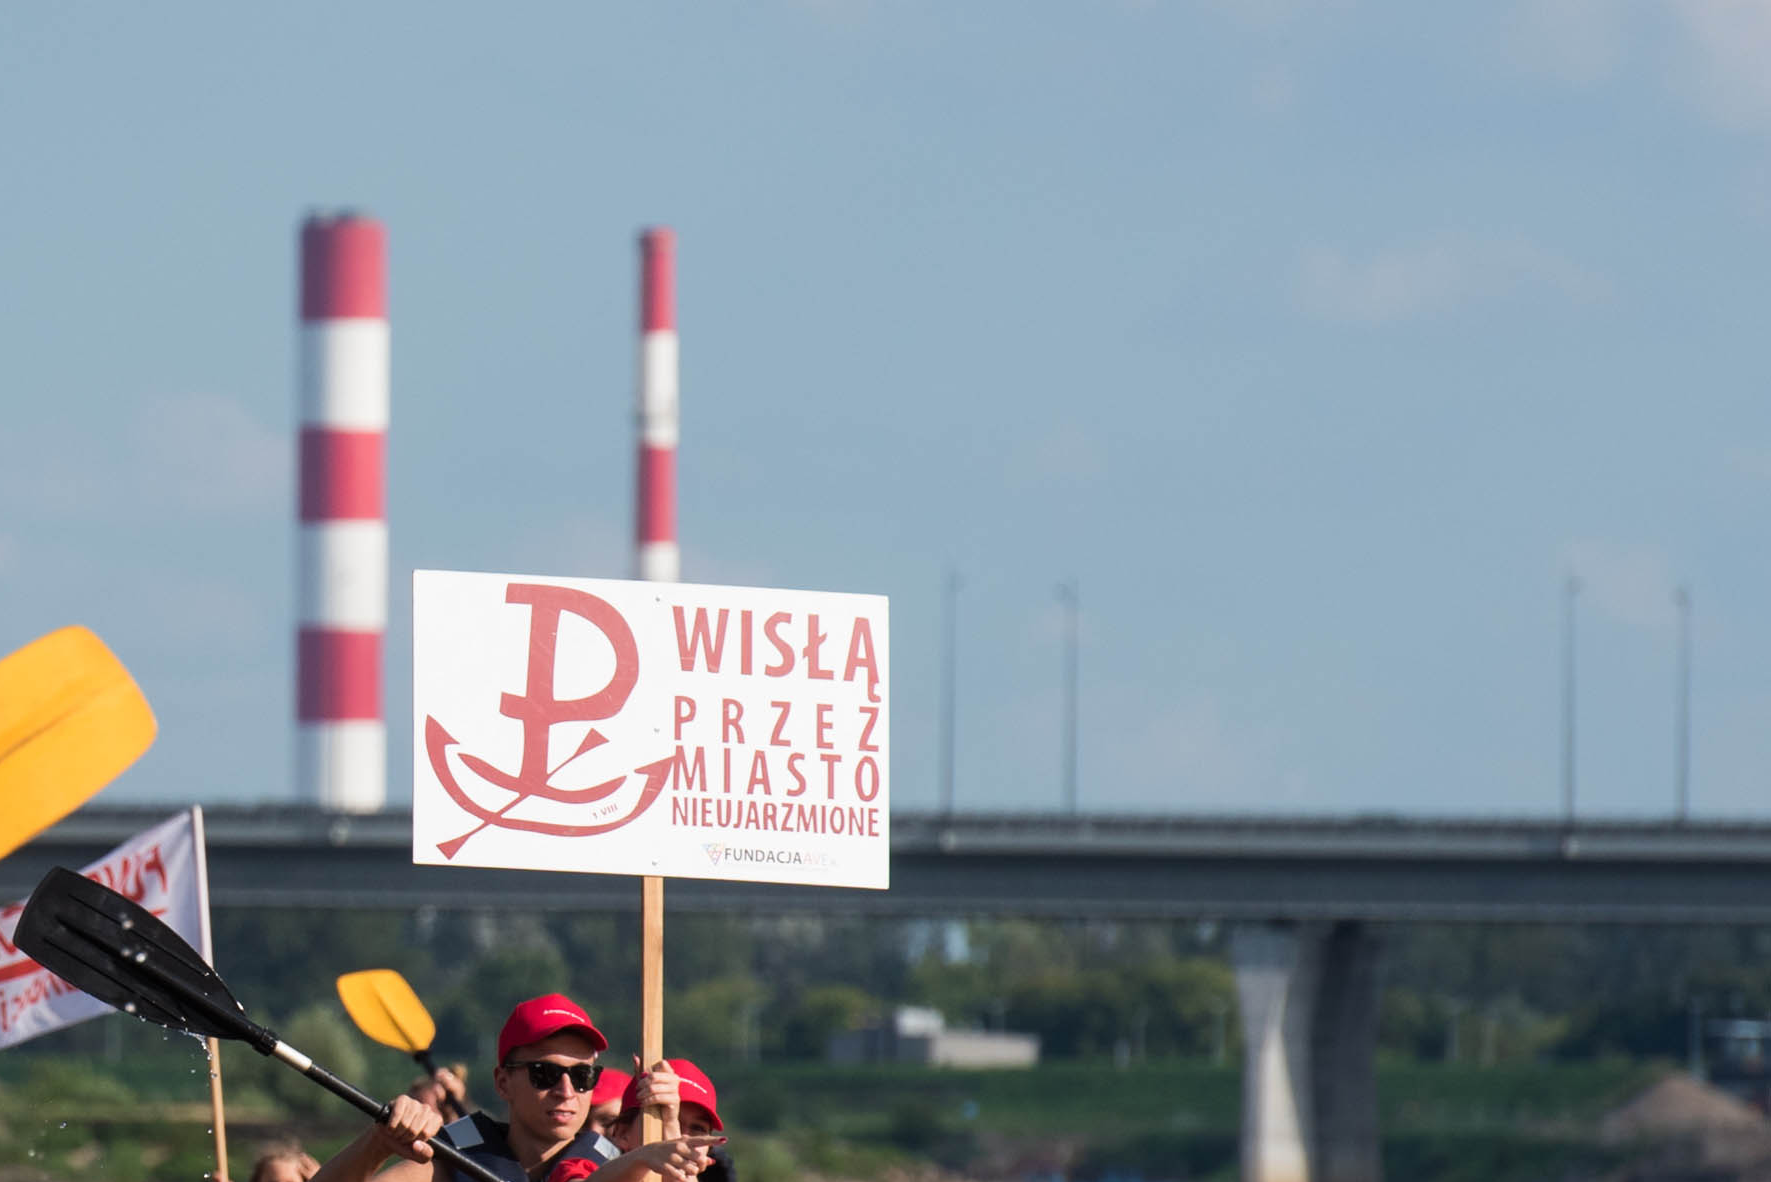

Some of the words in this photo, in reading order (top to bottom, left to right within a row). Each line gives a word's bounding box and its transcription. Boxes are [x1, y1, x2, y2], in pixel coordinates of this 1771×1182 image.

[672, 605, 881, 703] WISŁĄ
[674, 695, 880, 753] PRZEZ
[673, 745, 880, 803] MIASTO
[672, 796, 880, 838] NIEUJARZMIONE
